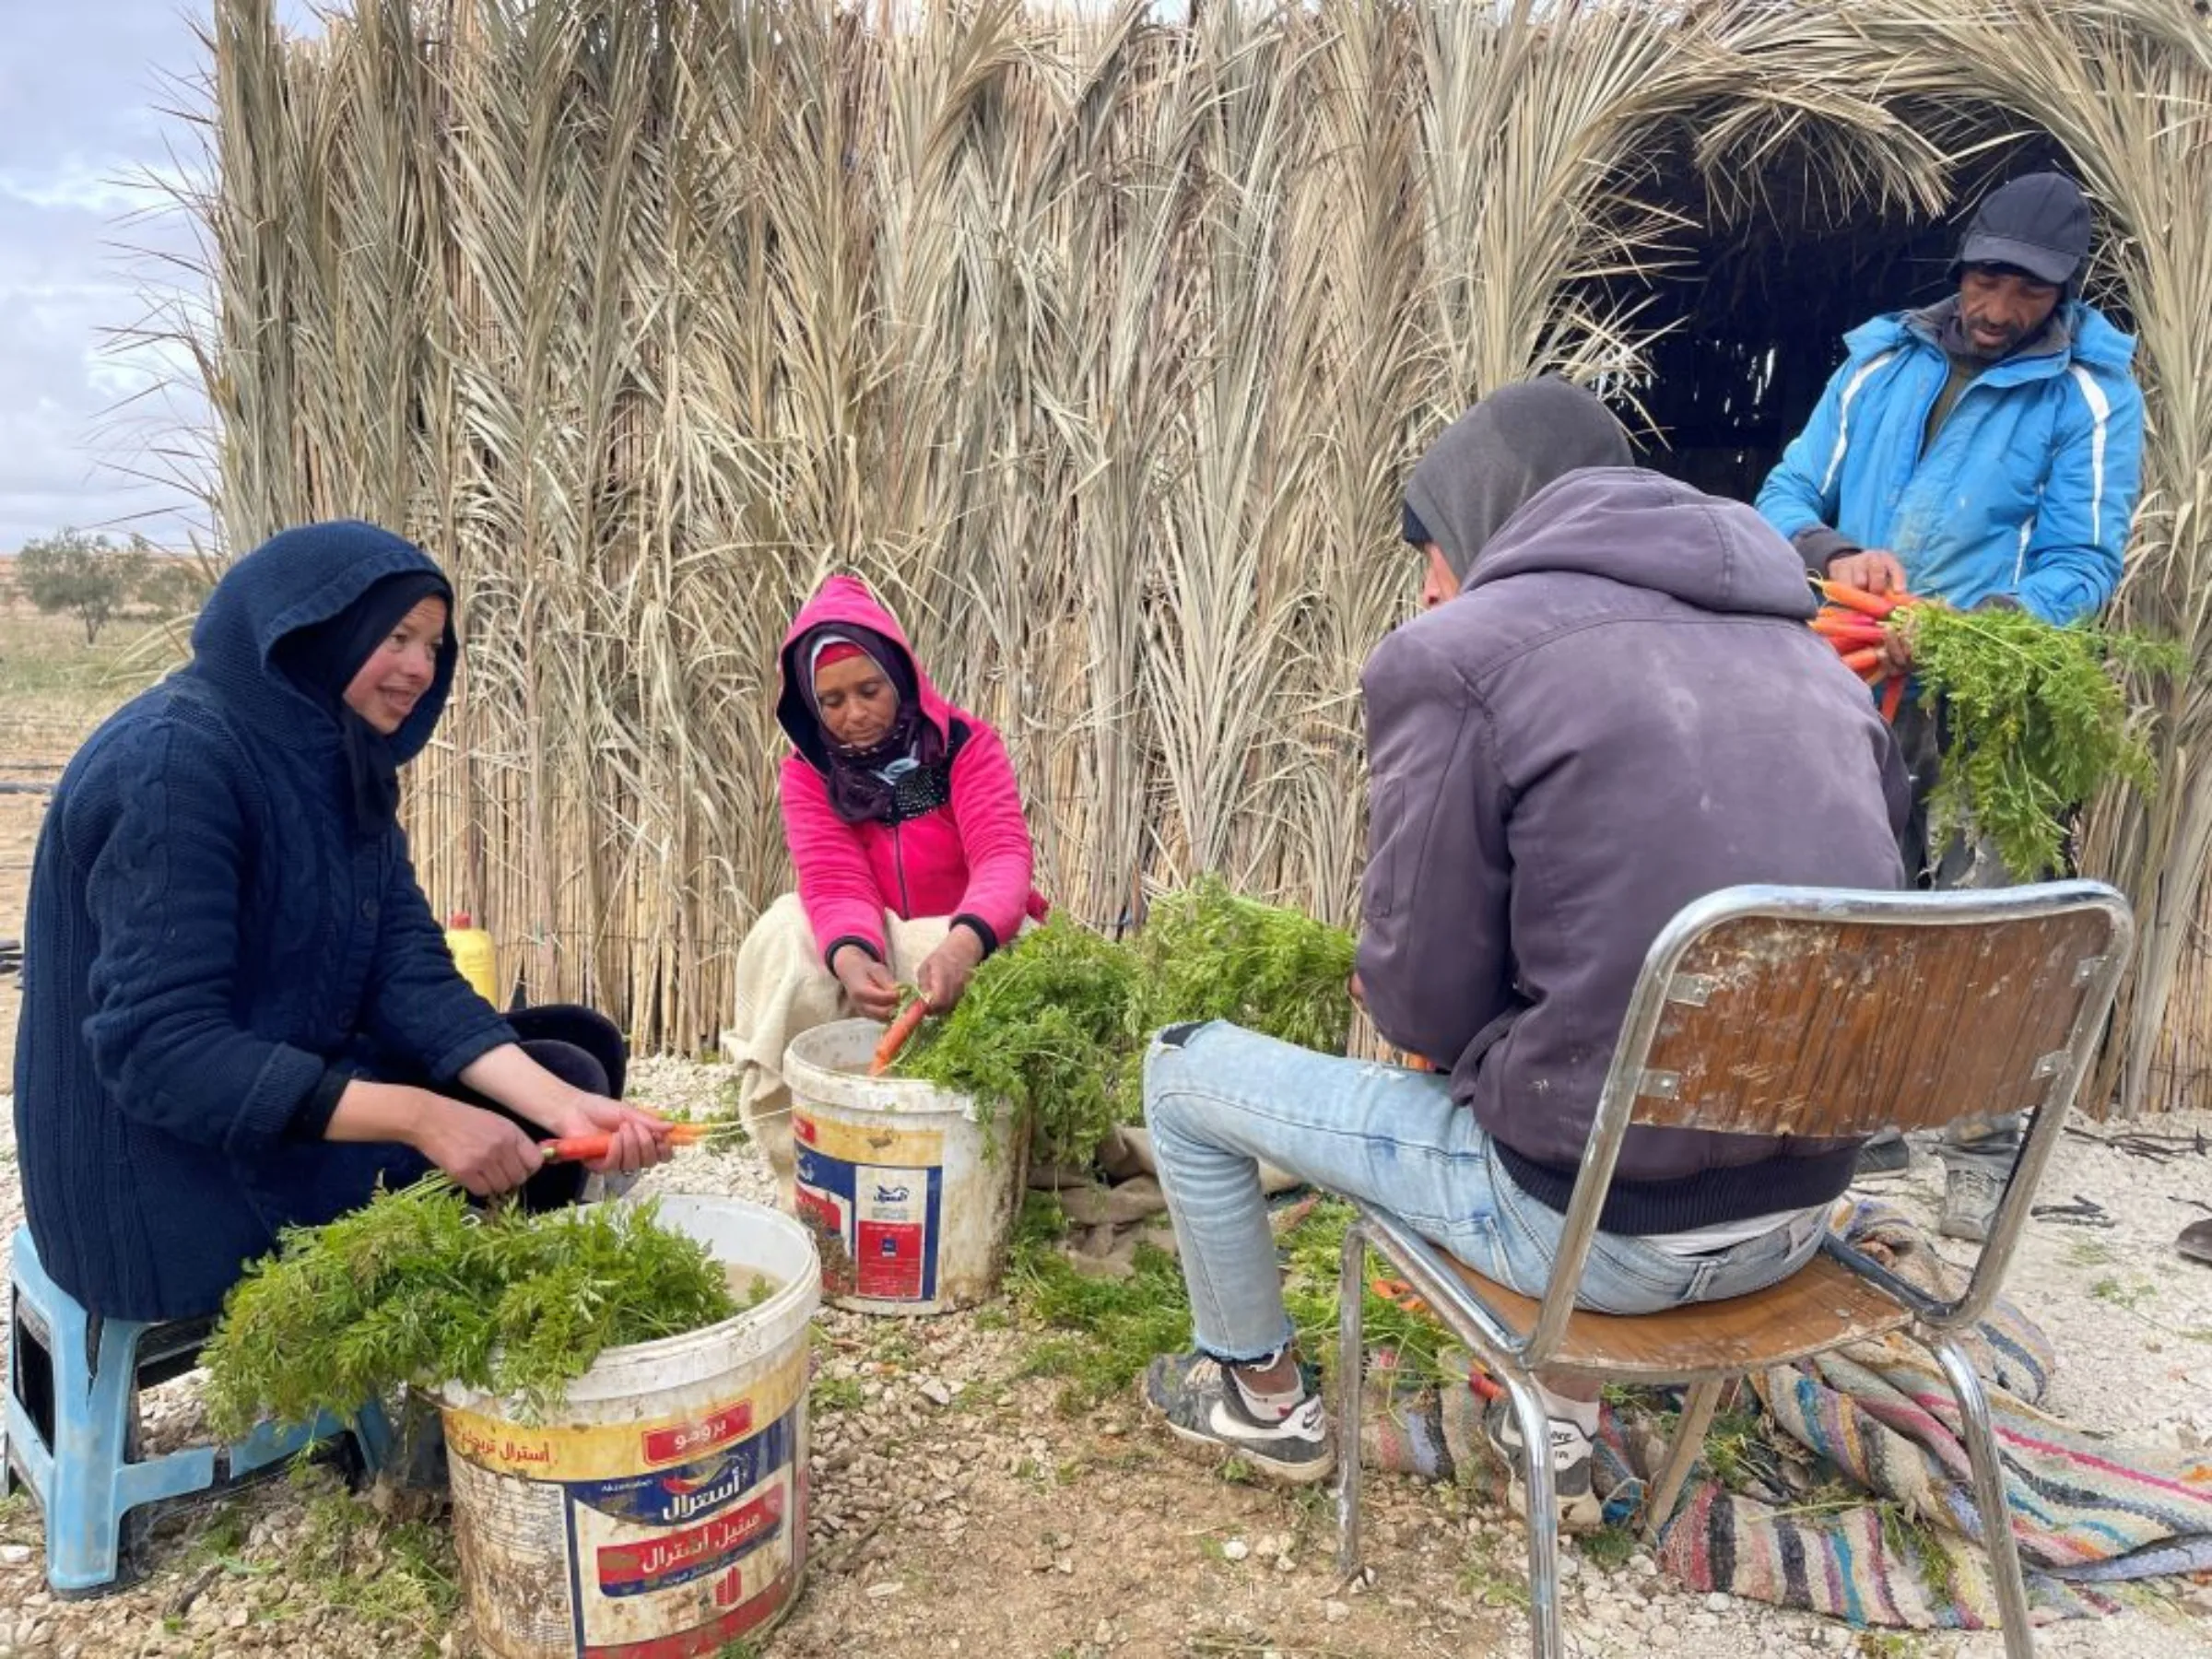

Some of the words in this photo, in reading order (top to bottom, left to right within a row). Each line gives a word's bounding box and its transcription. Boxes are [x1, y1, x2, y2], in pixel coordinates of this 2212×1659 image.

[499, 1441, 550, 1463] أسترال
[663, 1465, 740, 1521] أسترال
[642, 1525, 710, 1573] أسترال
